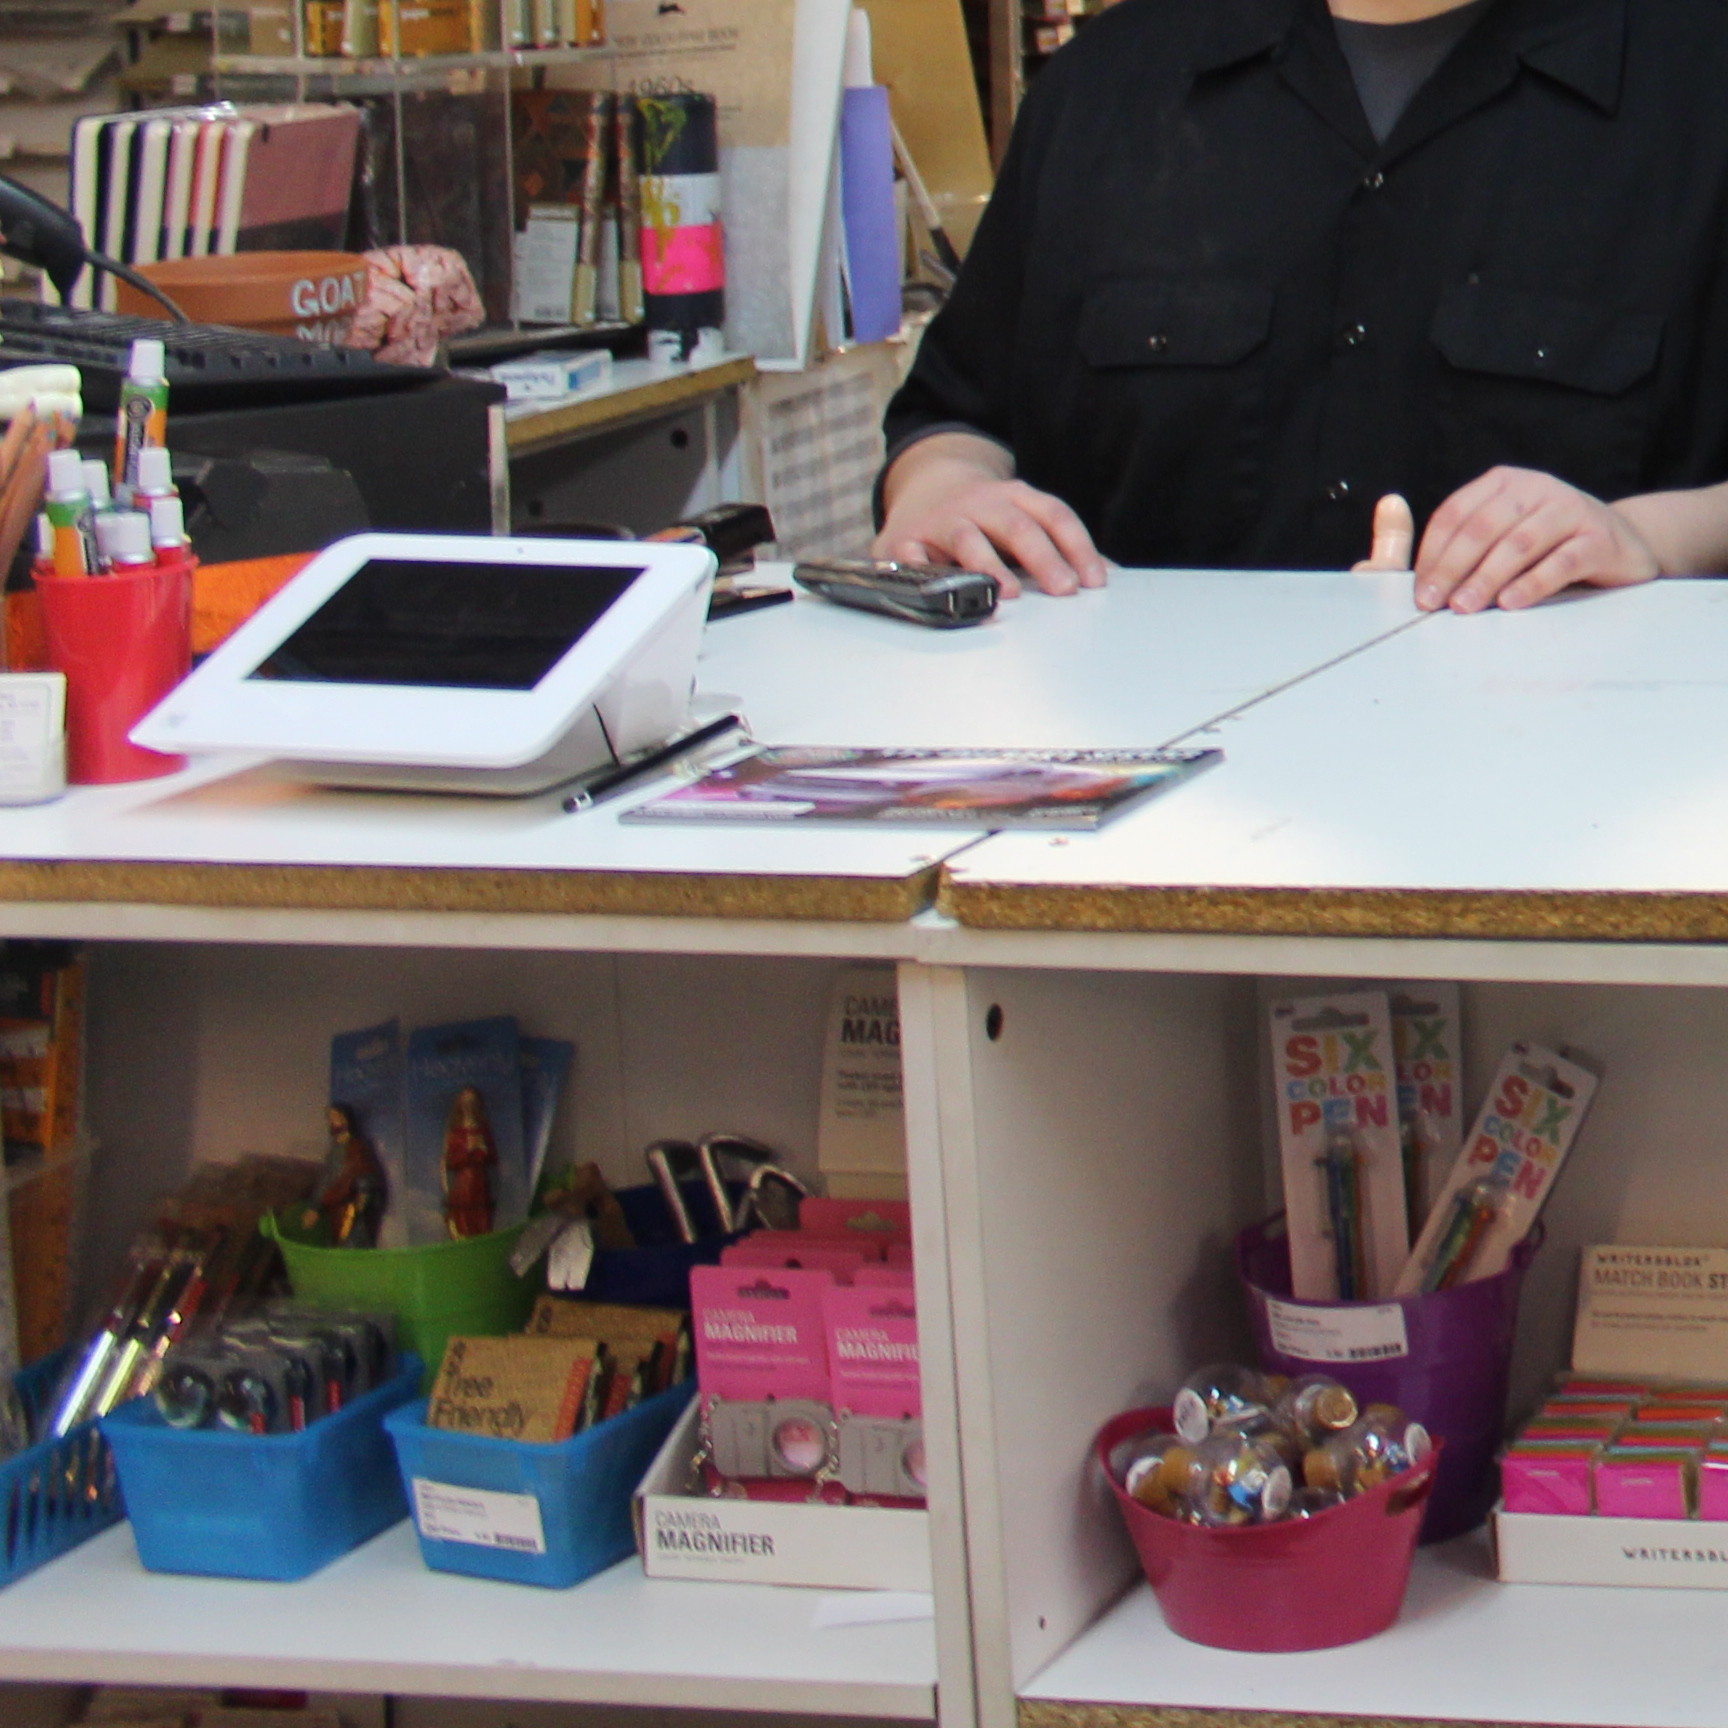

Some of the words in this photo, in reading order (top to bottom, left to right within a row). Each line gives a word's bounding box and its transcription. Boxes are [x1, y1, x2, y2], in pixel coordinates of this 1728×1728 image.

[1285, 1029, 1382, 1078] SIX
[1286, 1072, 1387, 1101] COLOR
[1398, 1083, 1452, 1117] EN
[1289, 1094, 1389, 1136] PEN
[1494, 1075, 1573, 1147] SIX
[1483, 1115, 1559, 1164] COLOR
[1468, 1133, 1548, 1201] PEN
[1594, 1268, 1653, 1287] MATCH
[1657, 1272, 1703, 1289] BOOK
[702, 1307, 757, 1324] CAMERA
[703, 1321, 798, 1344] MAGNIFIER
[834, 1327, 890, 1342] CAMERA
[654, 1509, 723, 1531] CAMERA
[656, 1528, 776, 1557] MAGNIFIER
